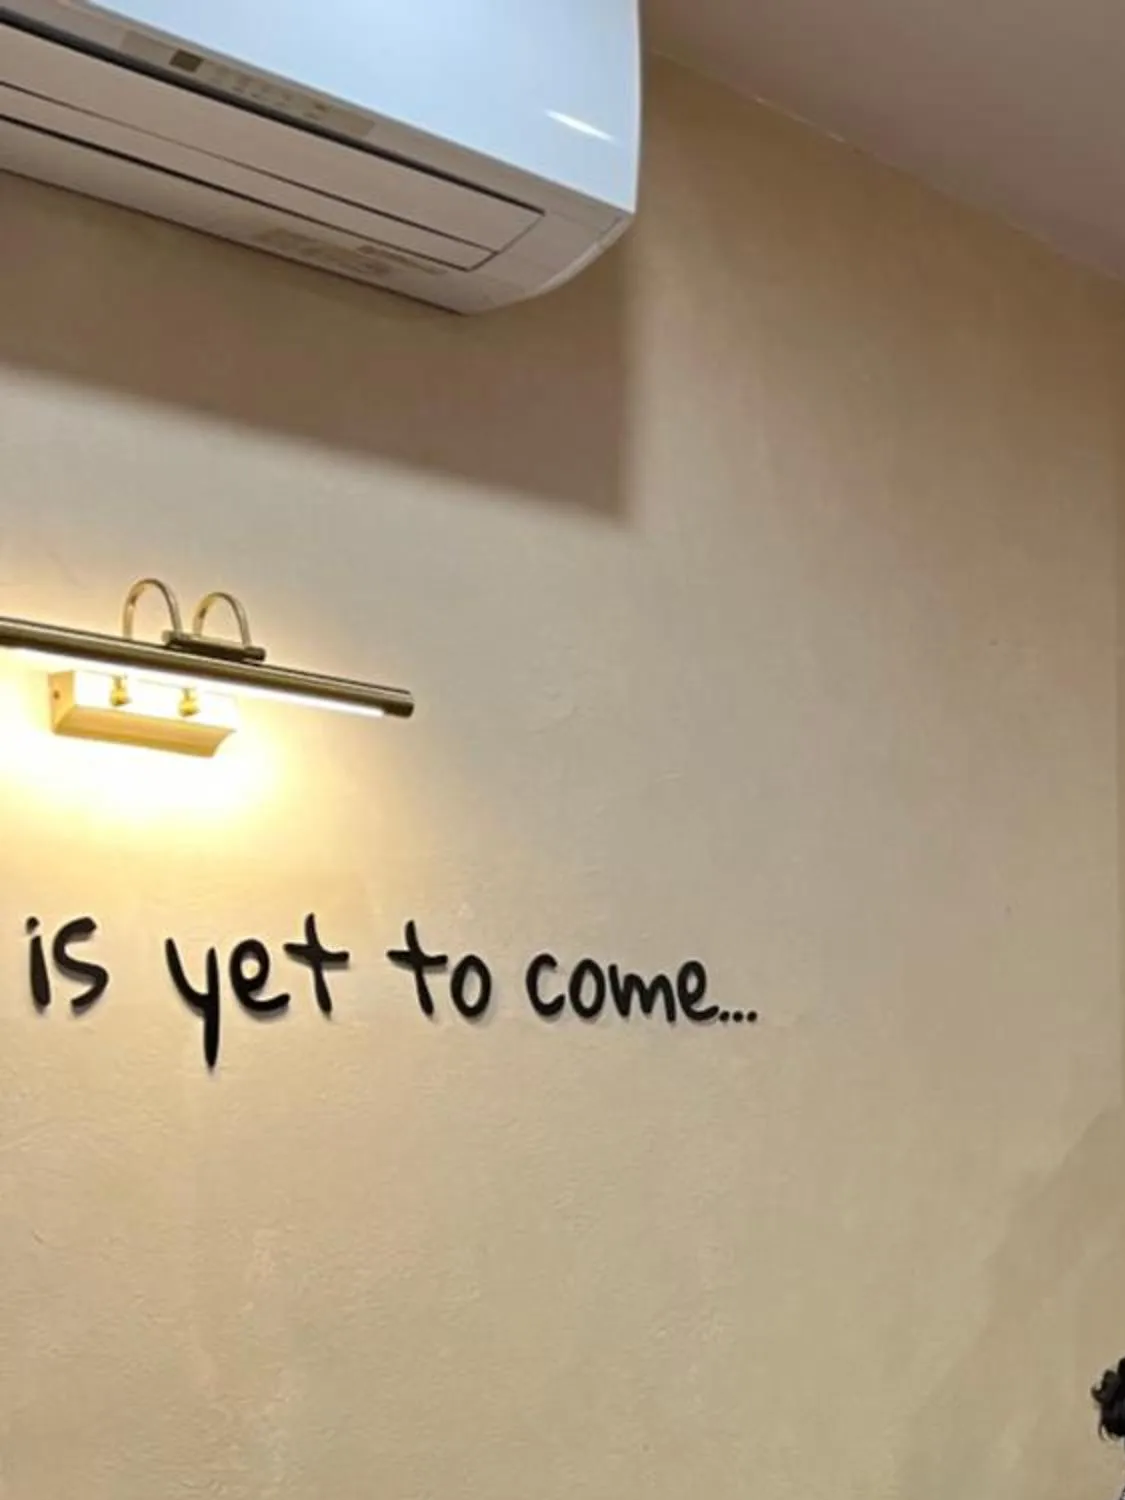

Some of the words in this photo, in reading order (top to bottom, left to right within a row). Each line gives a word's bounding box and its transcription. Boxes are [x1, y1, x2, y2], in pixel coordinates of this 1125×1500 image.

[26, 915, 108, 1013] is
[165, 912, 349, 1070] yet
[388, 920, 491, 1019] to
[525, 953, 758, 1023] come...
